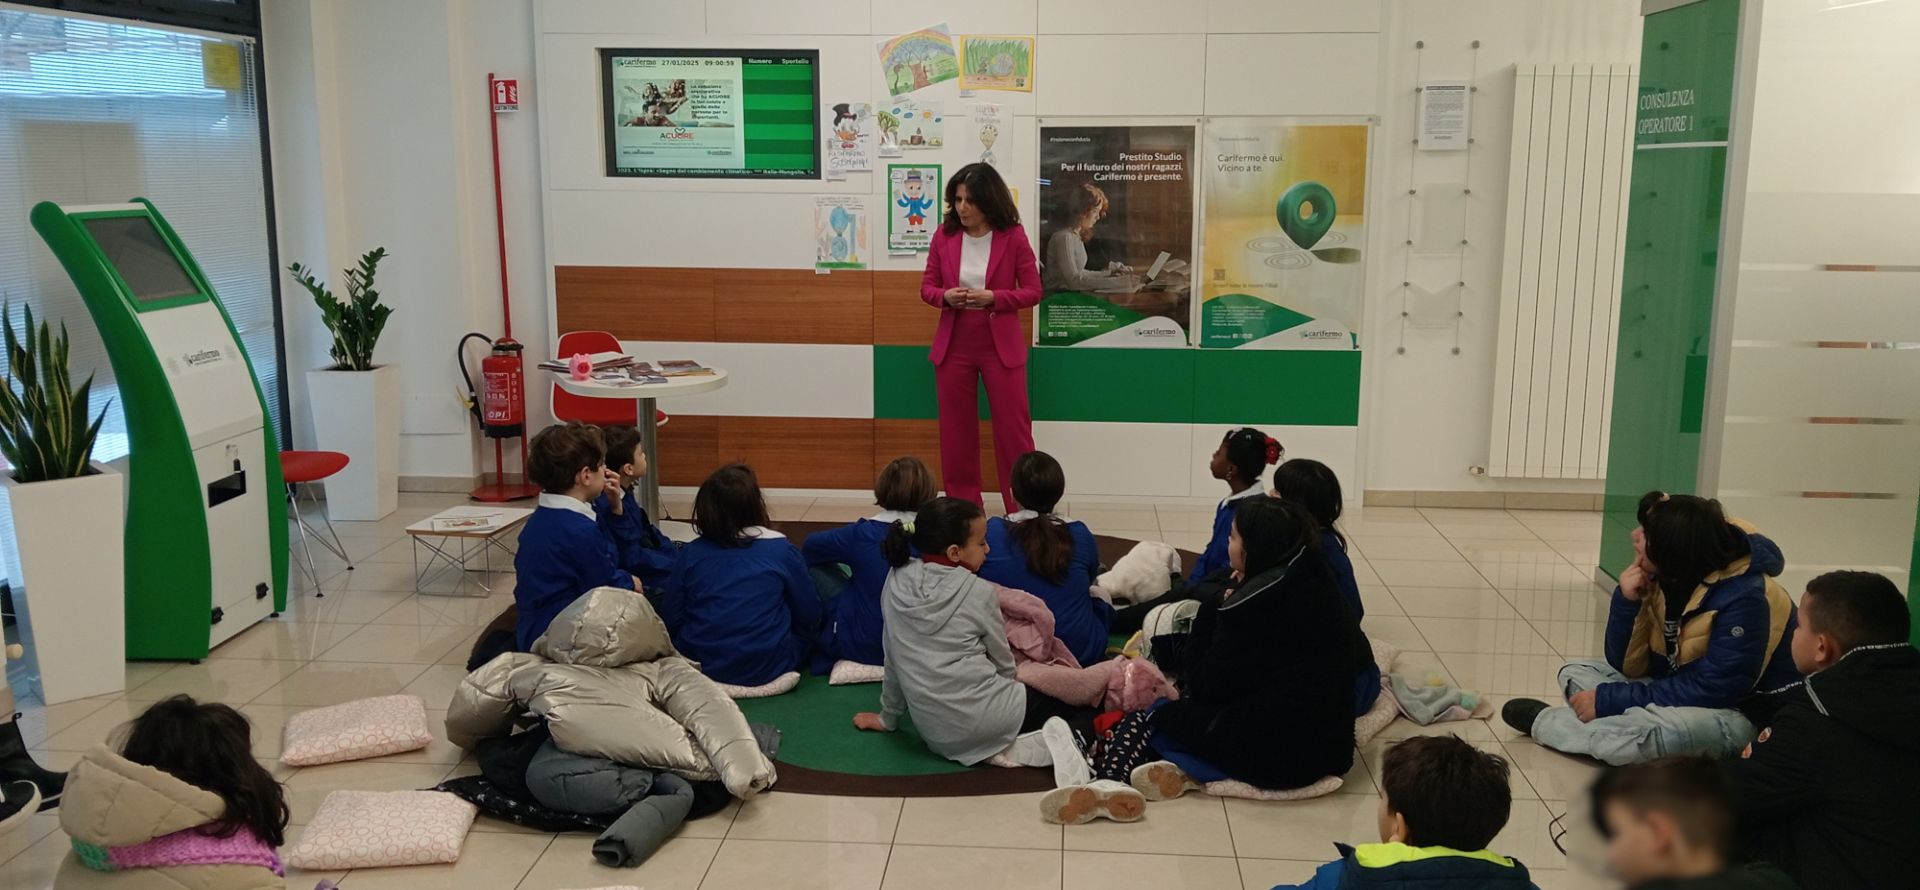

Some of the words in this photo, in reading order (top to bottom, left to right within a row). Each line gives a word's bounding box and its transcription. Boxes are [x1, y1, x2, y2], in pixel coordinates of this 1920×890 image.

[1640, 90, 1694, 110] CONSULENZA
[1638, 116, 1686, 134] OPERATORE
[1689, 116, 1694, 131] 1
[1154, 152, 1183, 161] Studio.
[1269, 154, 1284, 163] qui.
[1061, 163, 1075, 171] Per
[1077, 163, 1083, 171] il
[1084, 163, 1110, 171] futuro
[1111, 163, 1124, 171] dei
[1152, 163, 1183, 172] ragazzi.
[1094, 172, 1136, 180] Carifermo
